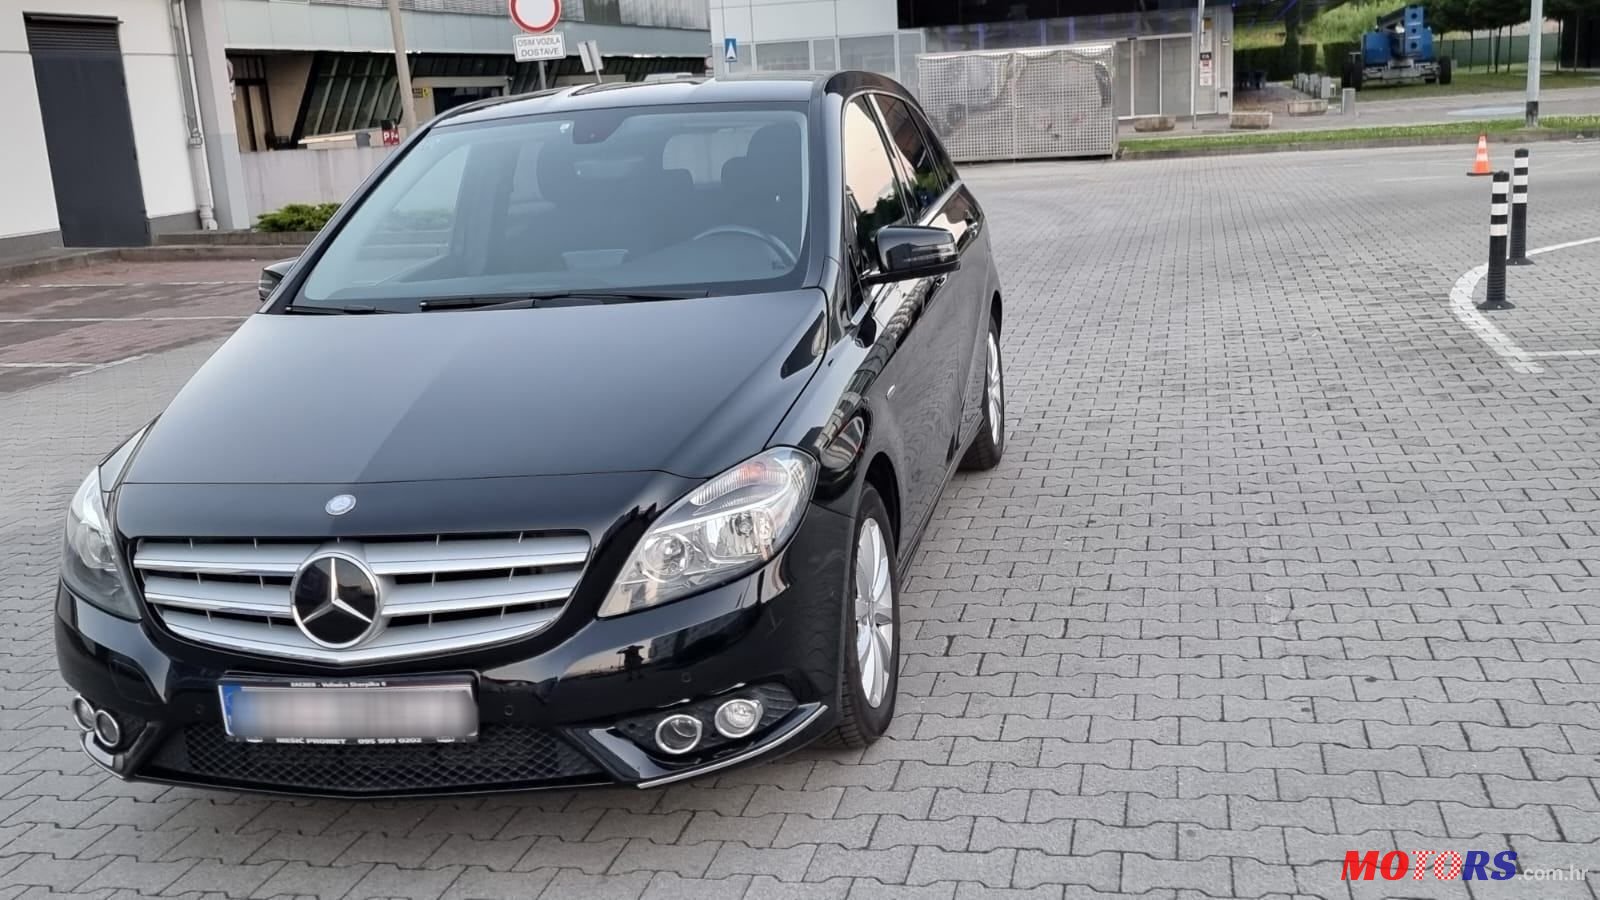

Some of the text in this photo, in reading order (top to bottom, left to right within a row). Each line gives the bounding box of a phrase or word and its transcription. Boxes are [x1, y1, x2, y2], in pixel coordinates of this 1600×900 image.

[518, 37, 561, 47] OSIM VOZILA
[521, 47, 560, 57] DOSTAVE
